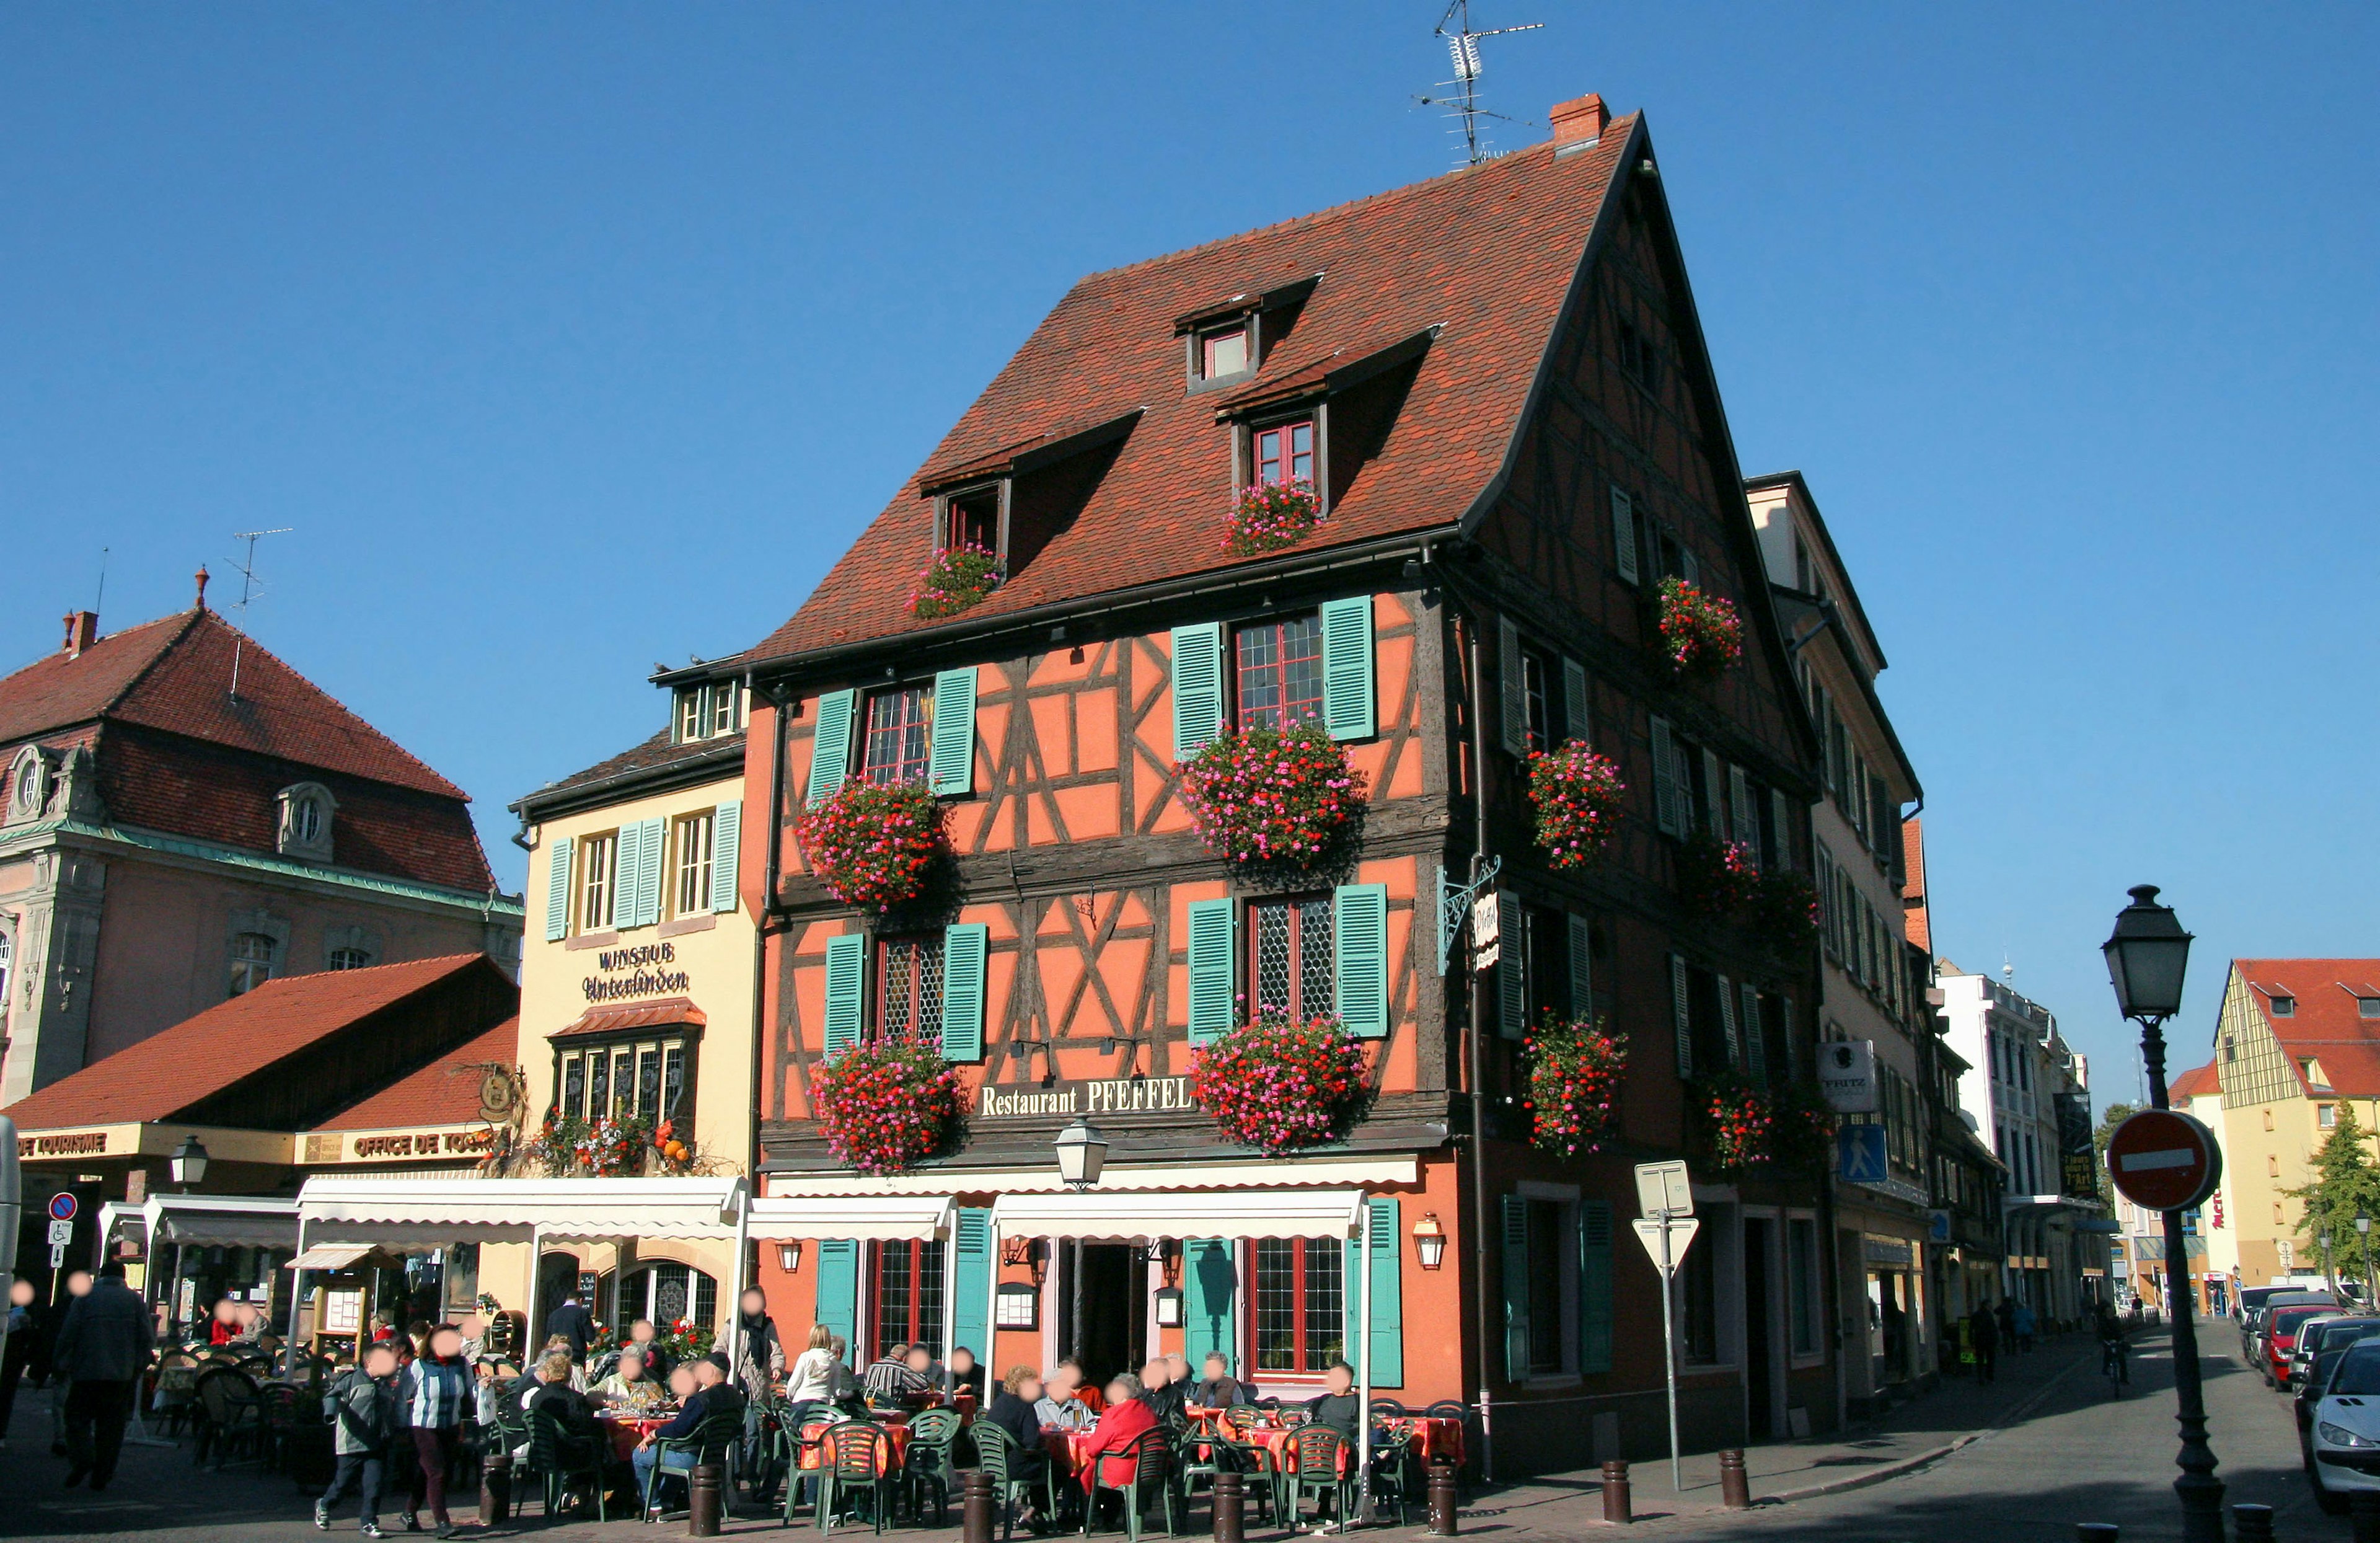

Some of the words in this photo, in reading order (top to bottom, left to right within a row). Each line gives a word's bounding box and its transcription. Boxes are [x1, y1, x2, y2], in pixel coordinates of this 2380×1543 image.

[599, 942, 672, 970] WINSTUB
[583, 966, 689, 1001] Unterlinden
[1823, 1078, 1866, 1087] FRITZ
[982, 1085, 1077, 1116] Restaurant
[1087, 1077, 1192, 1112] PFEFFEL
[37, 1133, 107, 1155] TOURISME
[355, 1135, 412, 1157] OFFICE
[415, 1134, 439, 1154] DE
